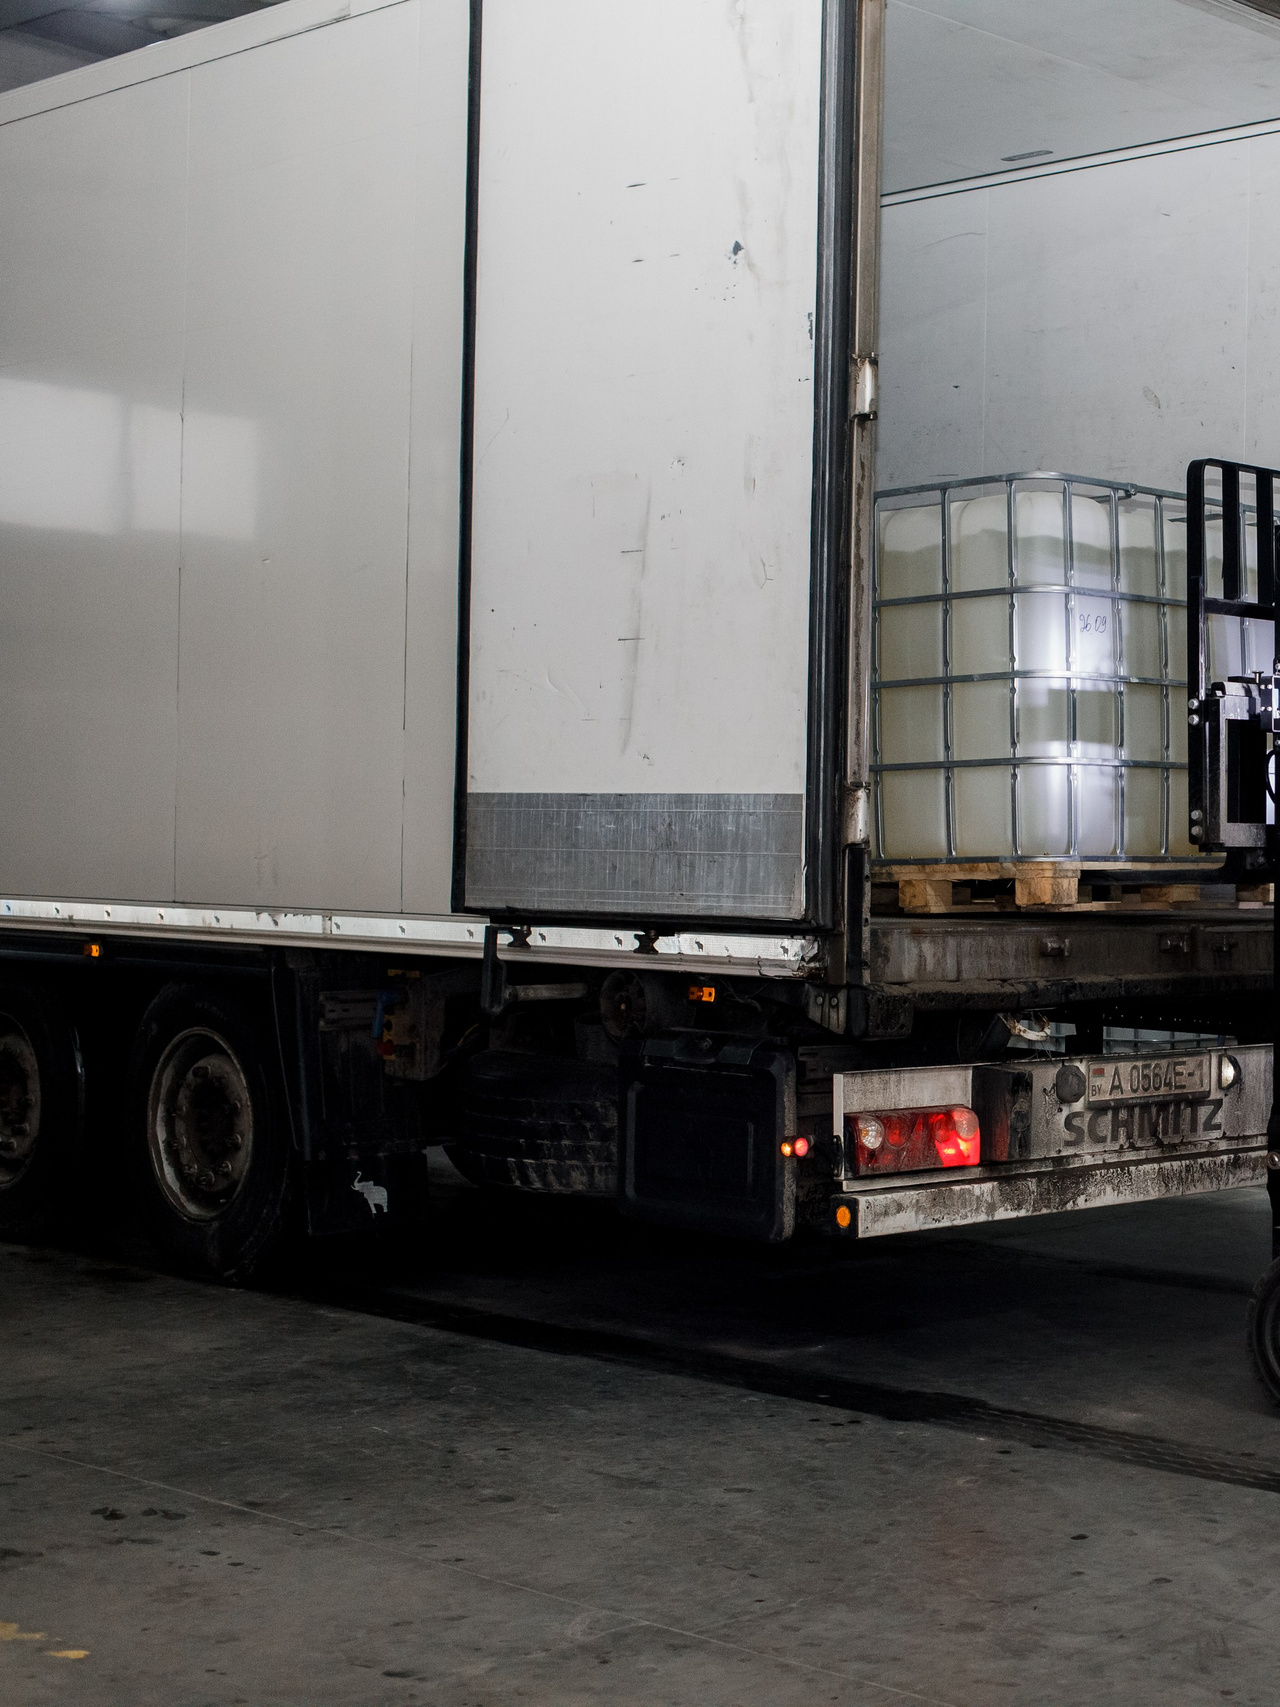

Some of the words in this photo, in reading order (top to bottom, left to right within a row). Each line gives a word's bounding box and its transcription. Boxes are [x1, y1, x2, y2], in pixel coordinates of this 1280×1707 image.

[1092, 1084, 1102, 1096] BY
[1109, 1066, 1124, 1096] A
[1129, 1060, 1204, 1093] 0564E-1
[1063, 1098, 1223, 1147] SCHMITZ
